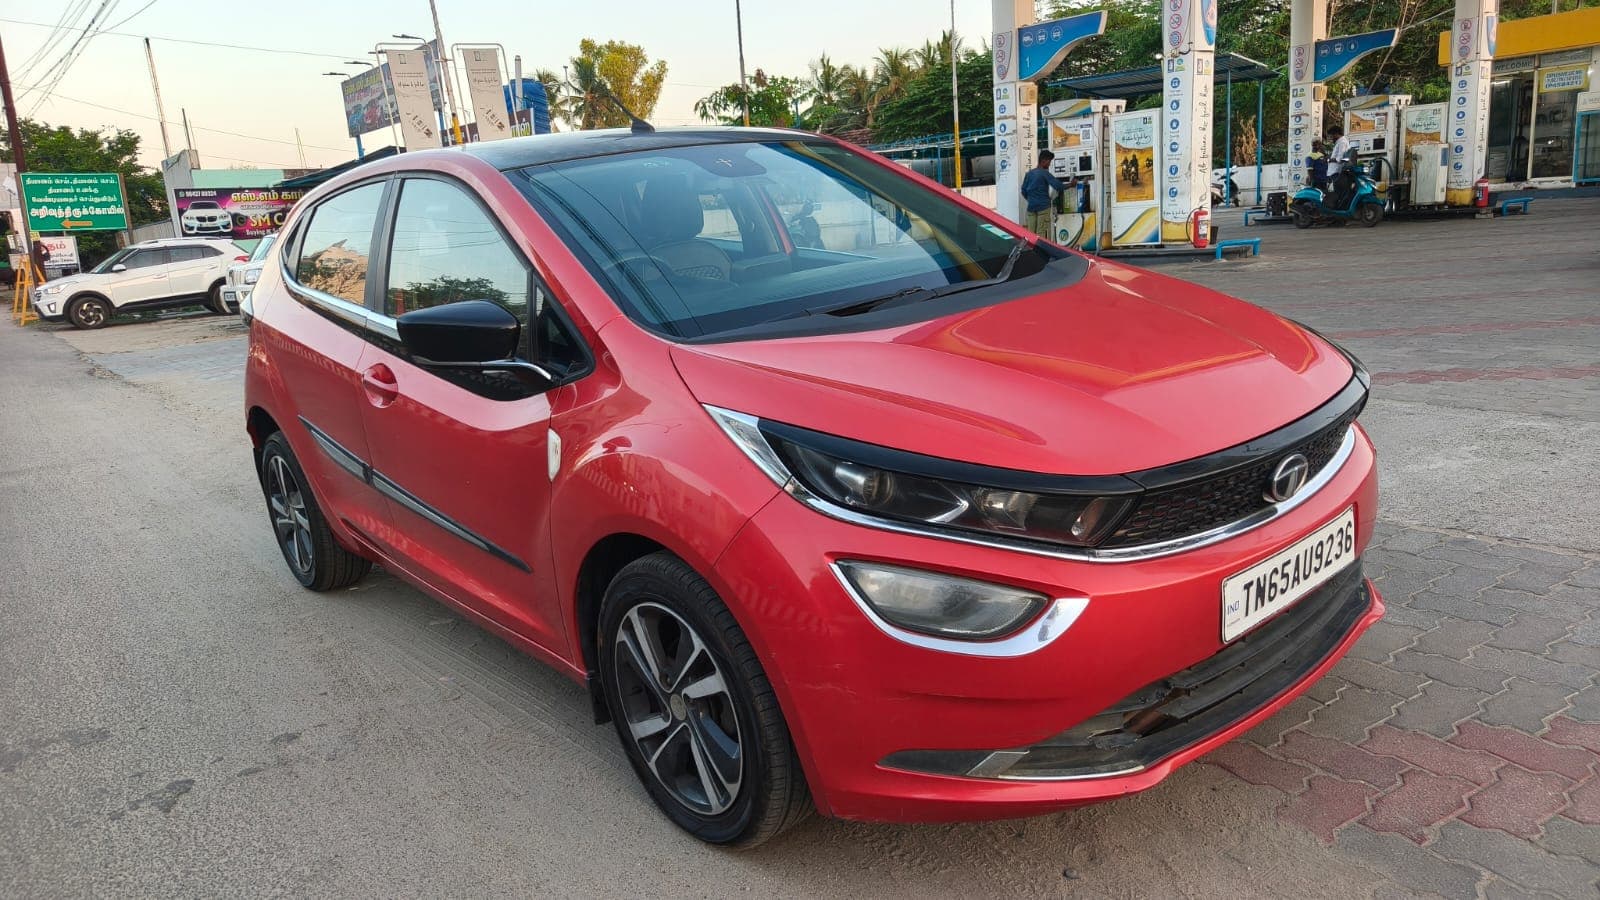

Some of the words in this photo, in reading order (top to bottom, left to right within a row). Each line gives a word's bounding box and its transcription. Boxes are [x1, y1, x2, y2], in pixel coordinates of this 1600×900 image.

[1025, 55, 1030, 69] 1
[1321, 64, 1327, 74] 3
[249, 213, 271, 227] SM
[1227, 600, 1240, 616] IND
[1243, 520, 1353, 618] TN65AU9236
